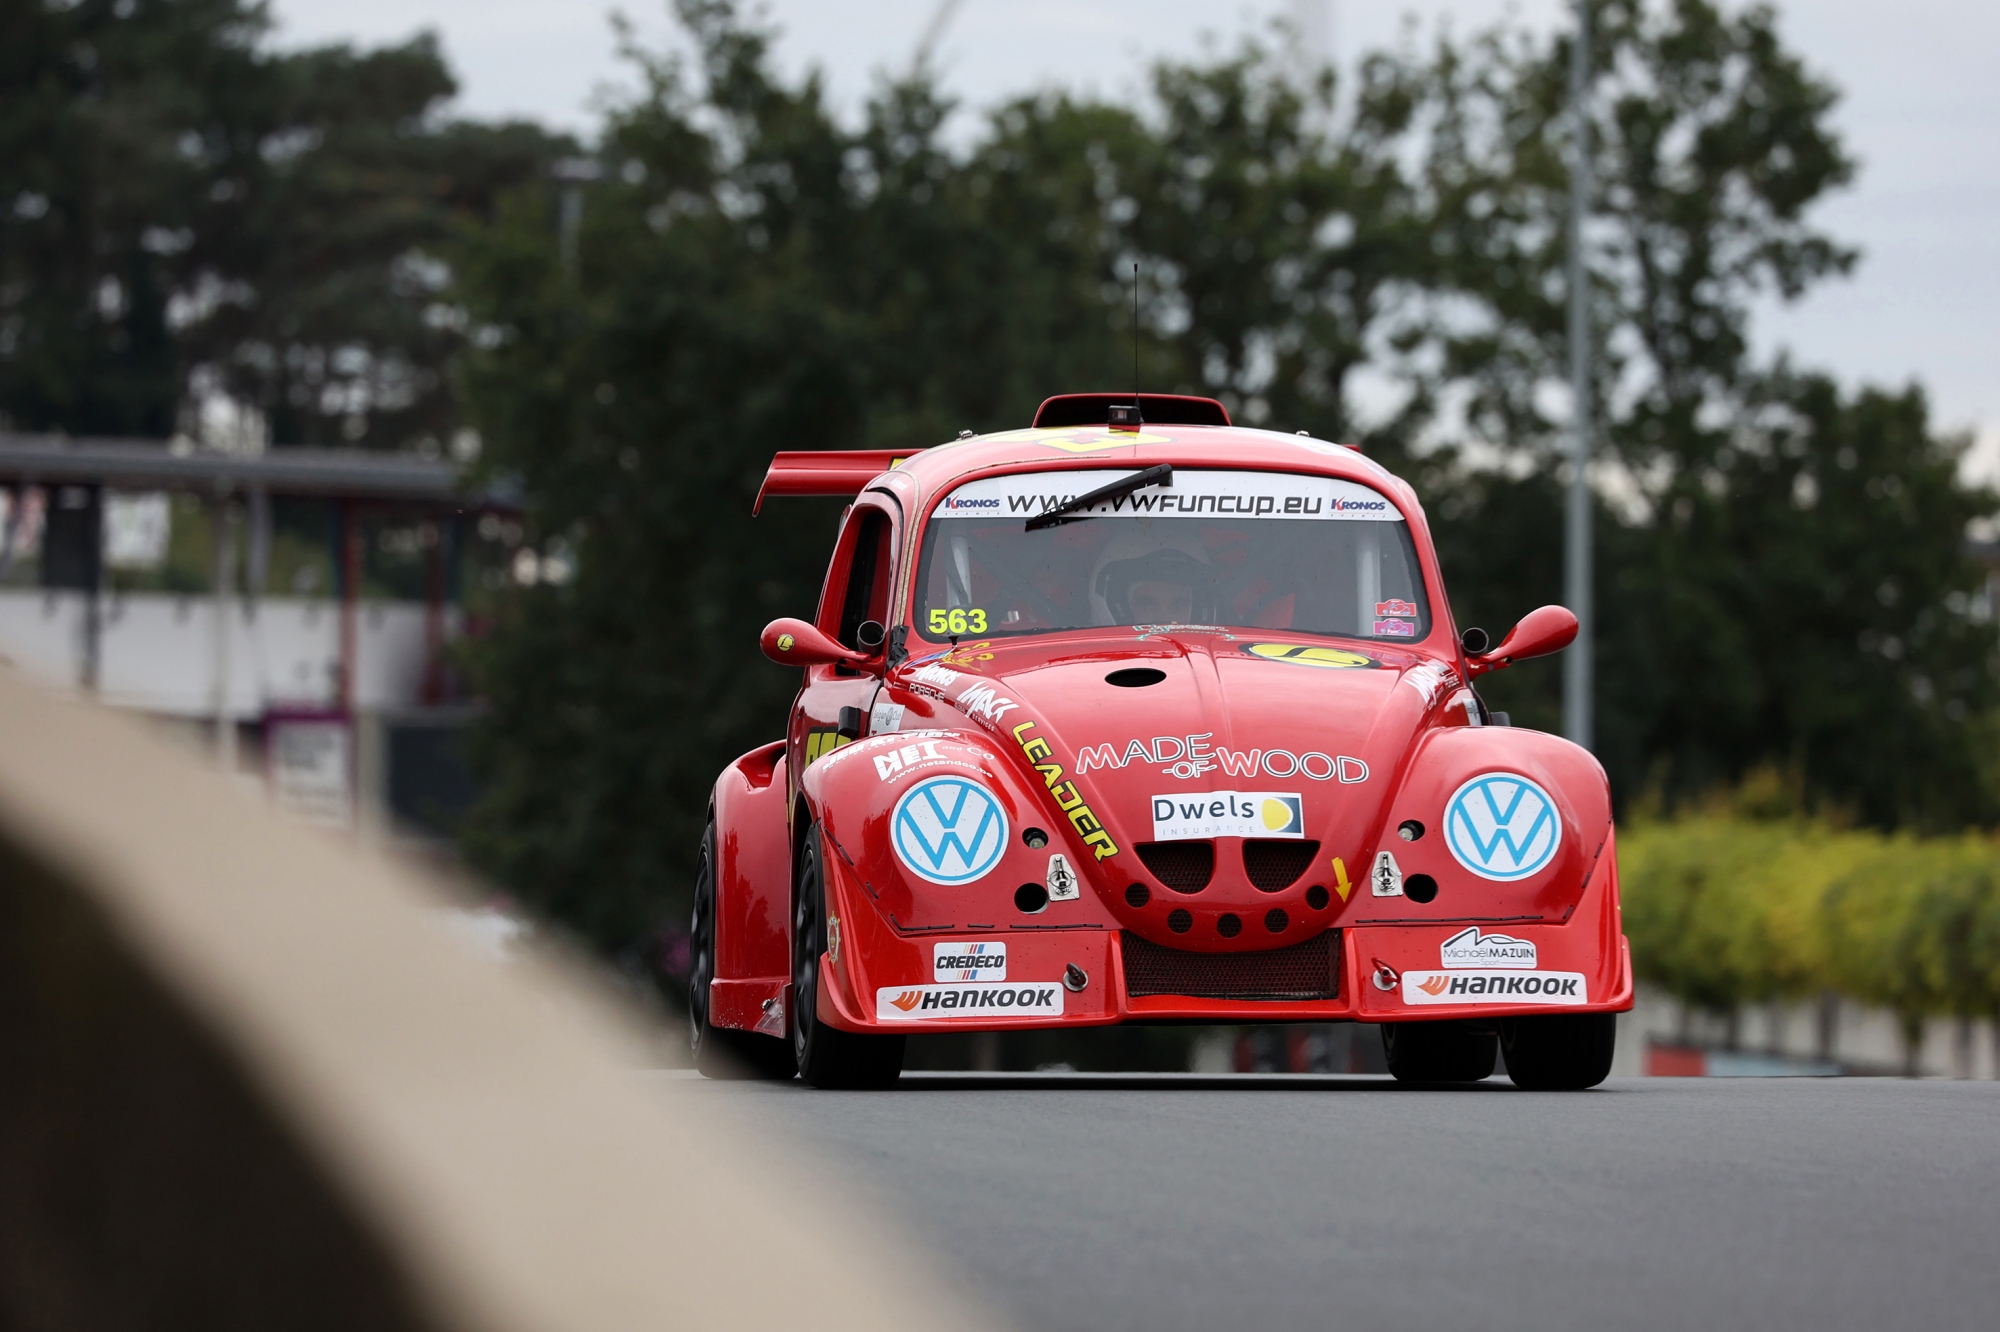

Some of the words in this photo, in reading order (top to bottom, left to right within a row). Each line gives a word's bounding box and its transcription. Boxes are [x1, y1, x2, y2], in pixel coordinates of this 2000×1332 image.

[945, 494, 1000, 509] KRONOS
[1331, 496, 1386, 511] KRONOS
[928, 608, 988, 634] 563
[909, 683, 946, 703] PORSCHE
[971, 713, 996, 732] SERVICES
[1076, 732, 1216, 774] MADE
[1216, 747, 1370, 784] WOOD
[888, 760, 993, 784] www.netandco.be
[1012, 720, 1120, 863] LEADER
[1154, 795, 1255, 822] Dwels
[1162, 825, 1254, 836] INSURANCE
[936, 955, 1005, 969] CREDECO
